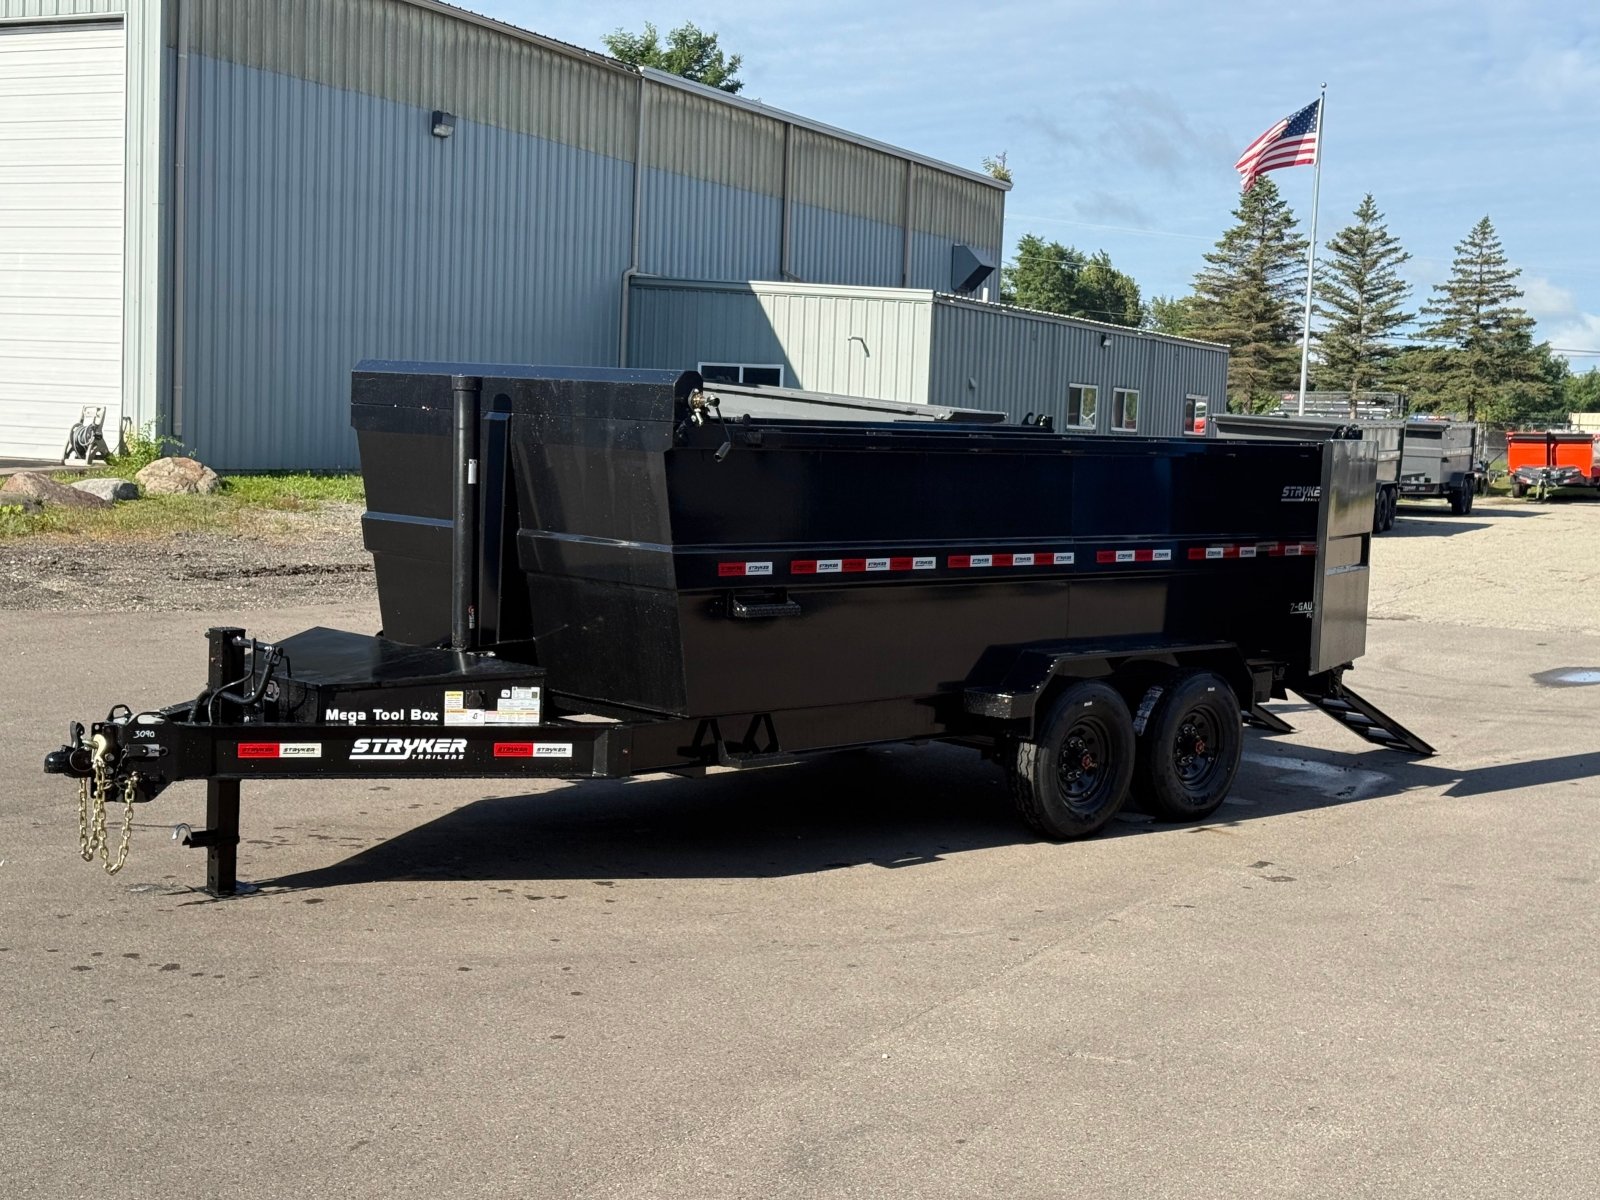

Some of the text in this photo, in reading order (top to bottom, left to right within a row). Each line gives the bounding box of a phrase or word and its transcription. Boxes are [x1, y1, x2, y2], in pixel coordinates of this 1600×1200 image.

[1281, 486, 1321, 502] STRYKE
[1290, 602, 1313, 612] 7-GAU
[326, 709, 367, 726] Mega
[373, 709, 404, 720] Tool
[411, 709, 439, 720] Box
[133, 730, 155, 739] 3090
[283, 747, 316, 755] STRYKER
[349, 738, 468, 760] STRYKER
